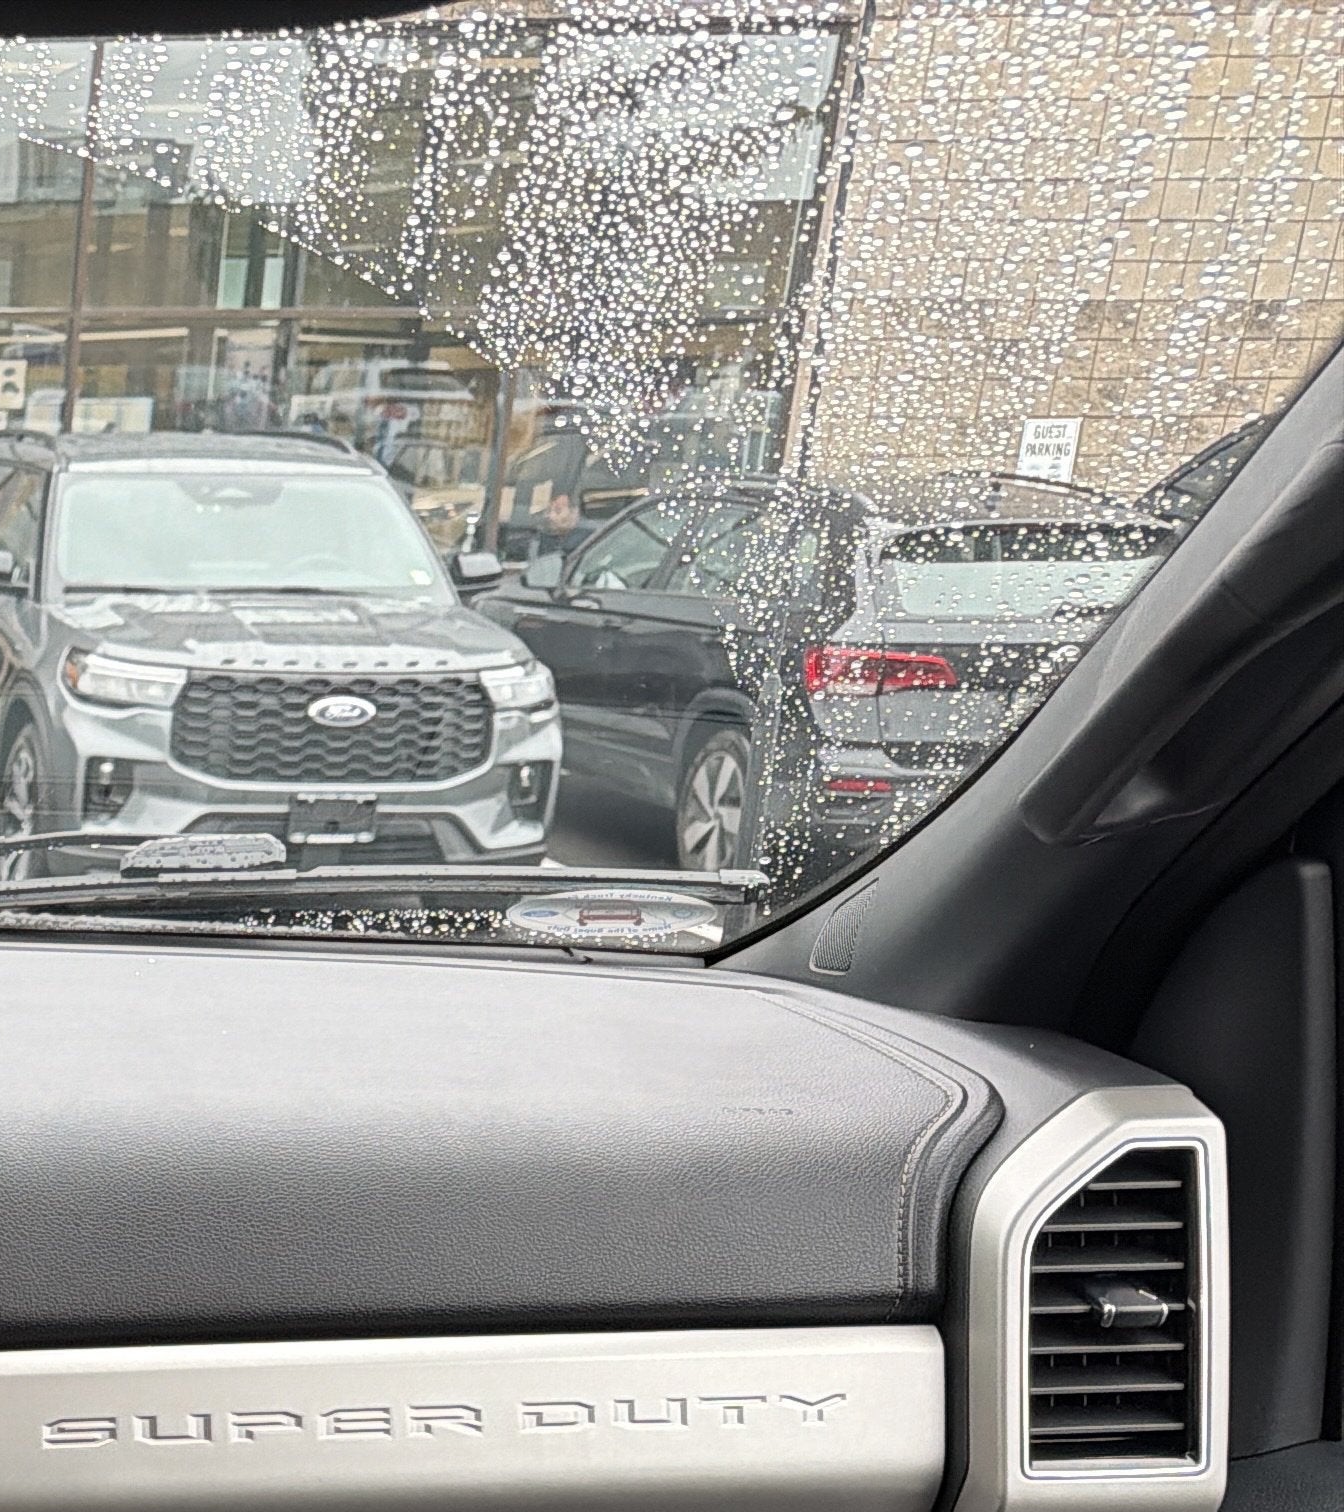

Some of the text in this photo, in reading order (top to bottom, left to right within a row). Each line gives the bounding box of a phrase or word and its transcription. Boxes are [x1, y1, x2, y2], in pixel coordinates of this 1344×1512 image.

[1033, 424, 1068, 439] GUEST
[1025, 442, 1072, 457] PARKING
[41, 1390, 849, 1452] SUPER DUTY
